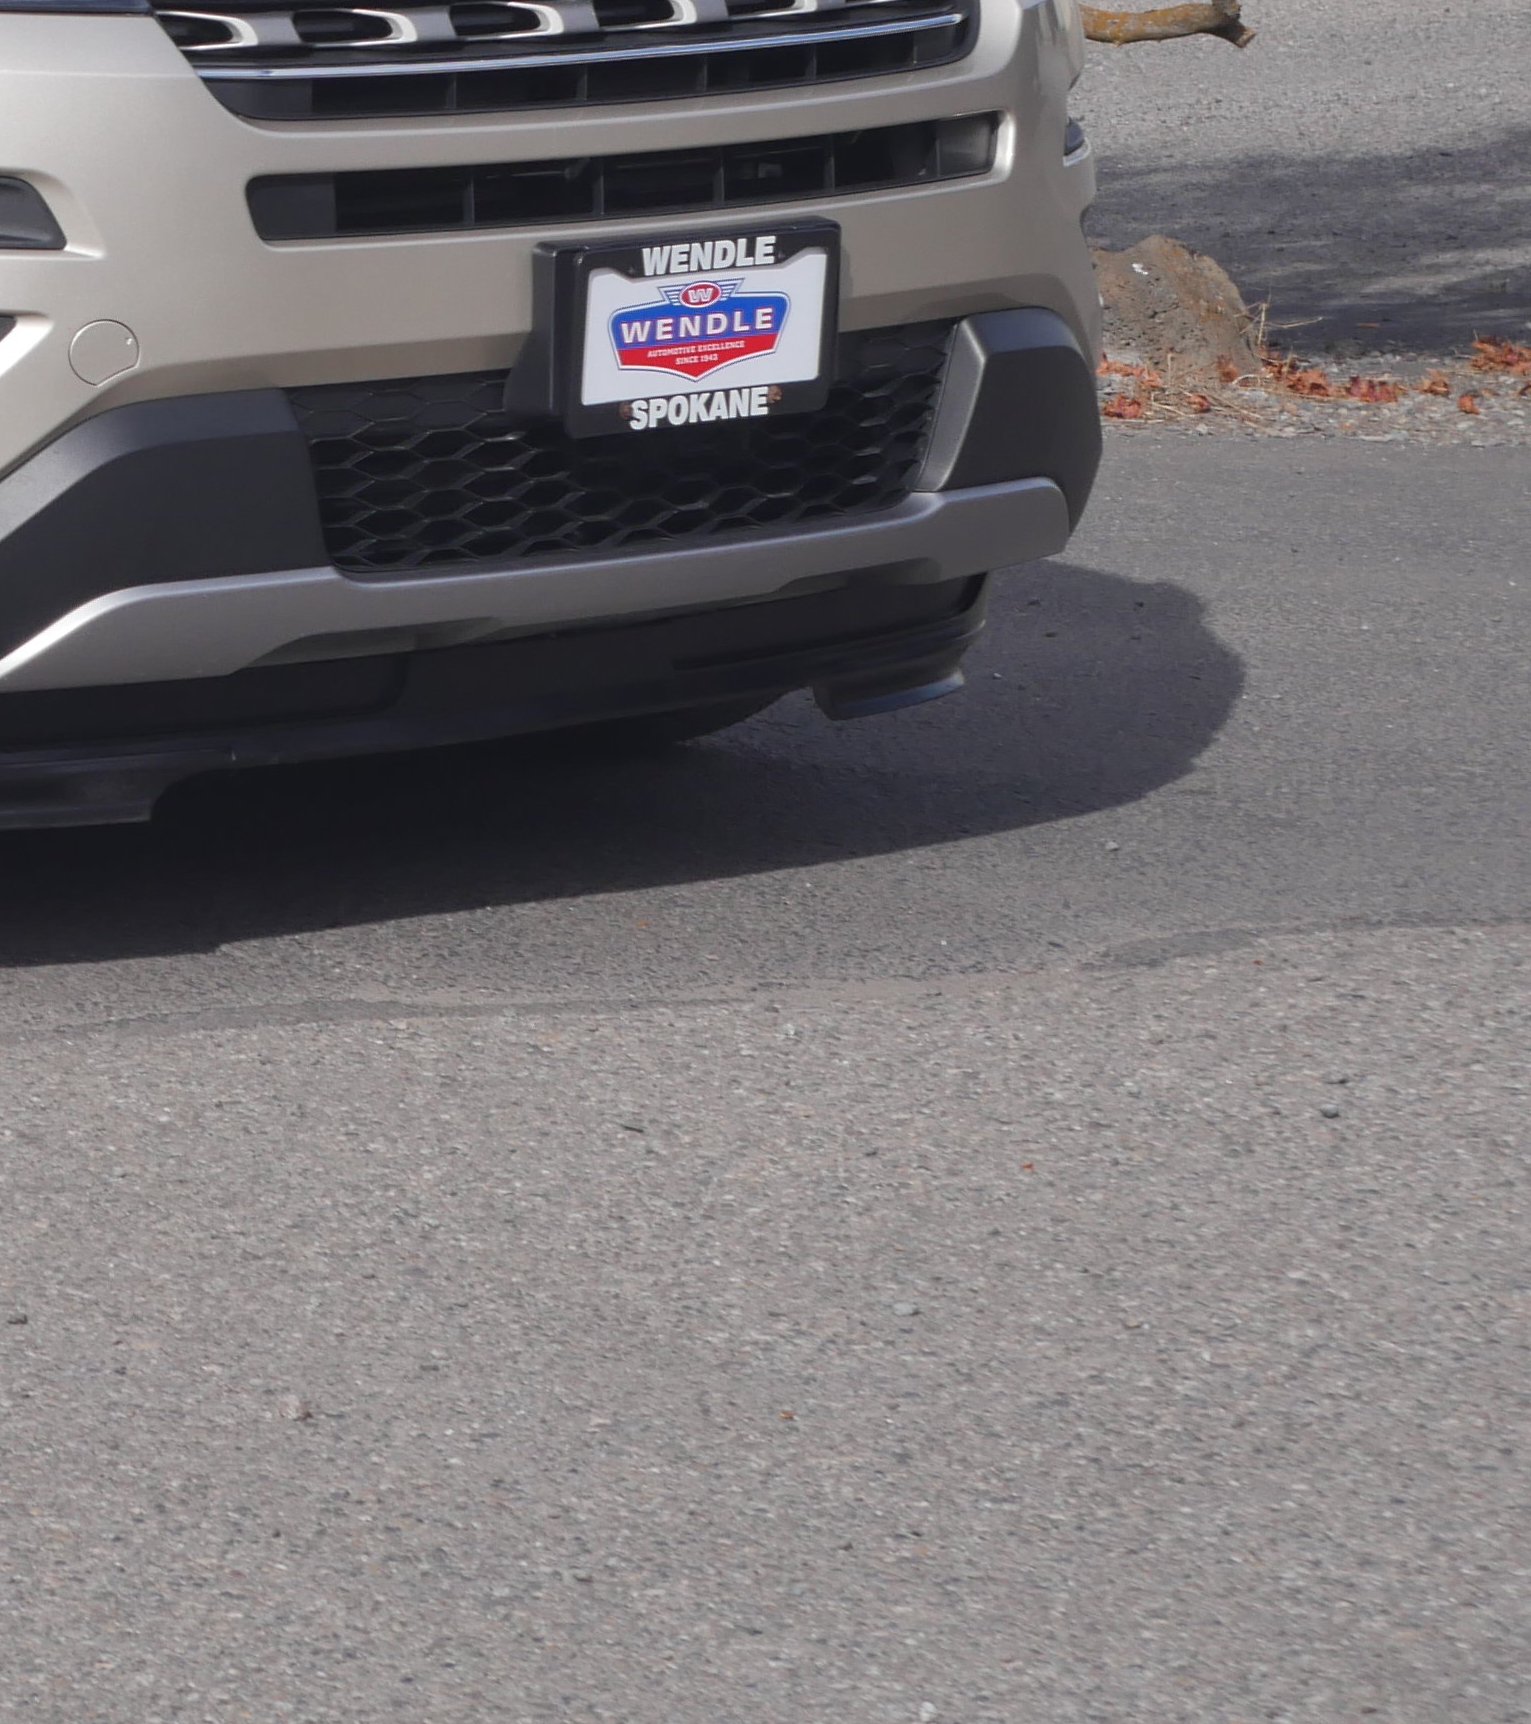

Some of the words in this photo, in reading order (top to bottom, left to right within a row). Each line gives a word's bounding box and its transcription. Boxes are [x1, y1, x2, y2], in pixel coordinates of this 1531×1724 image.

[641, 235, 777, 277] WENDLE
[687, 287, 714, 303] W
[620, 307, 774, 344] WENDLE
[647, 345, 697, 358] AUTOMOTIVE
[697, 340, 745, 352] EXCELLENCE
[675, 355, 699, 365] SINCE
[700, 353, 719, 363] 1943
[629, 385, 770, 430] SPOKANE
